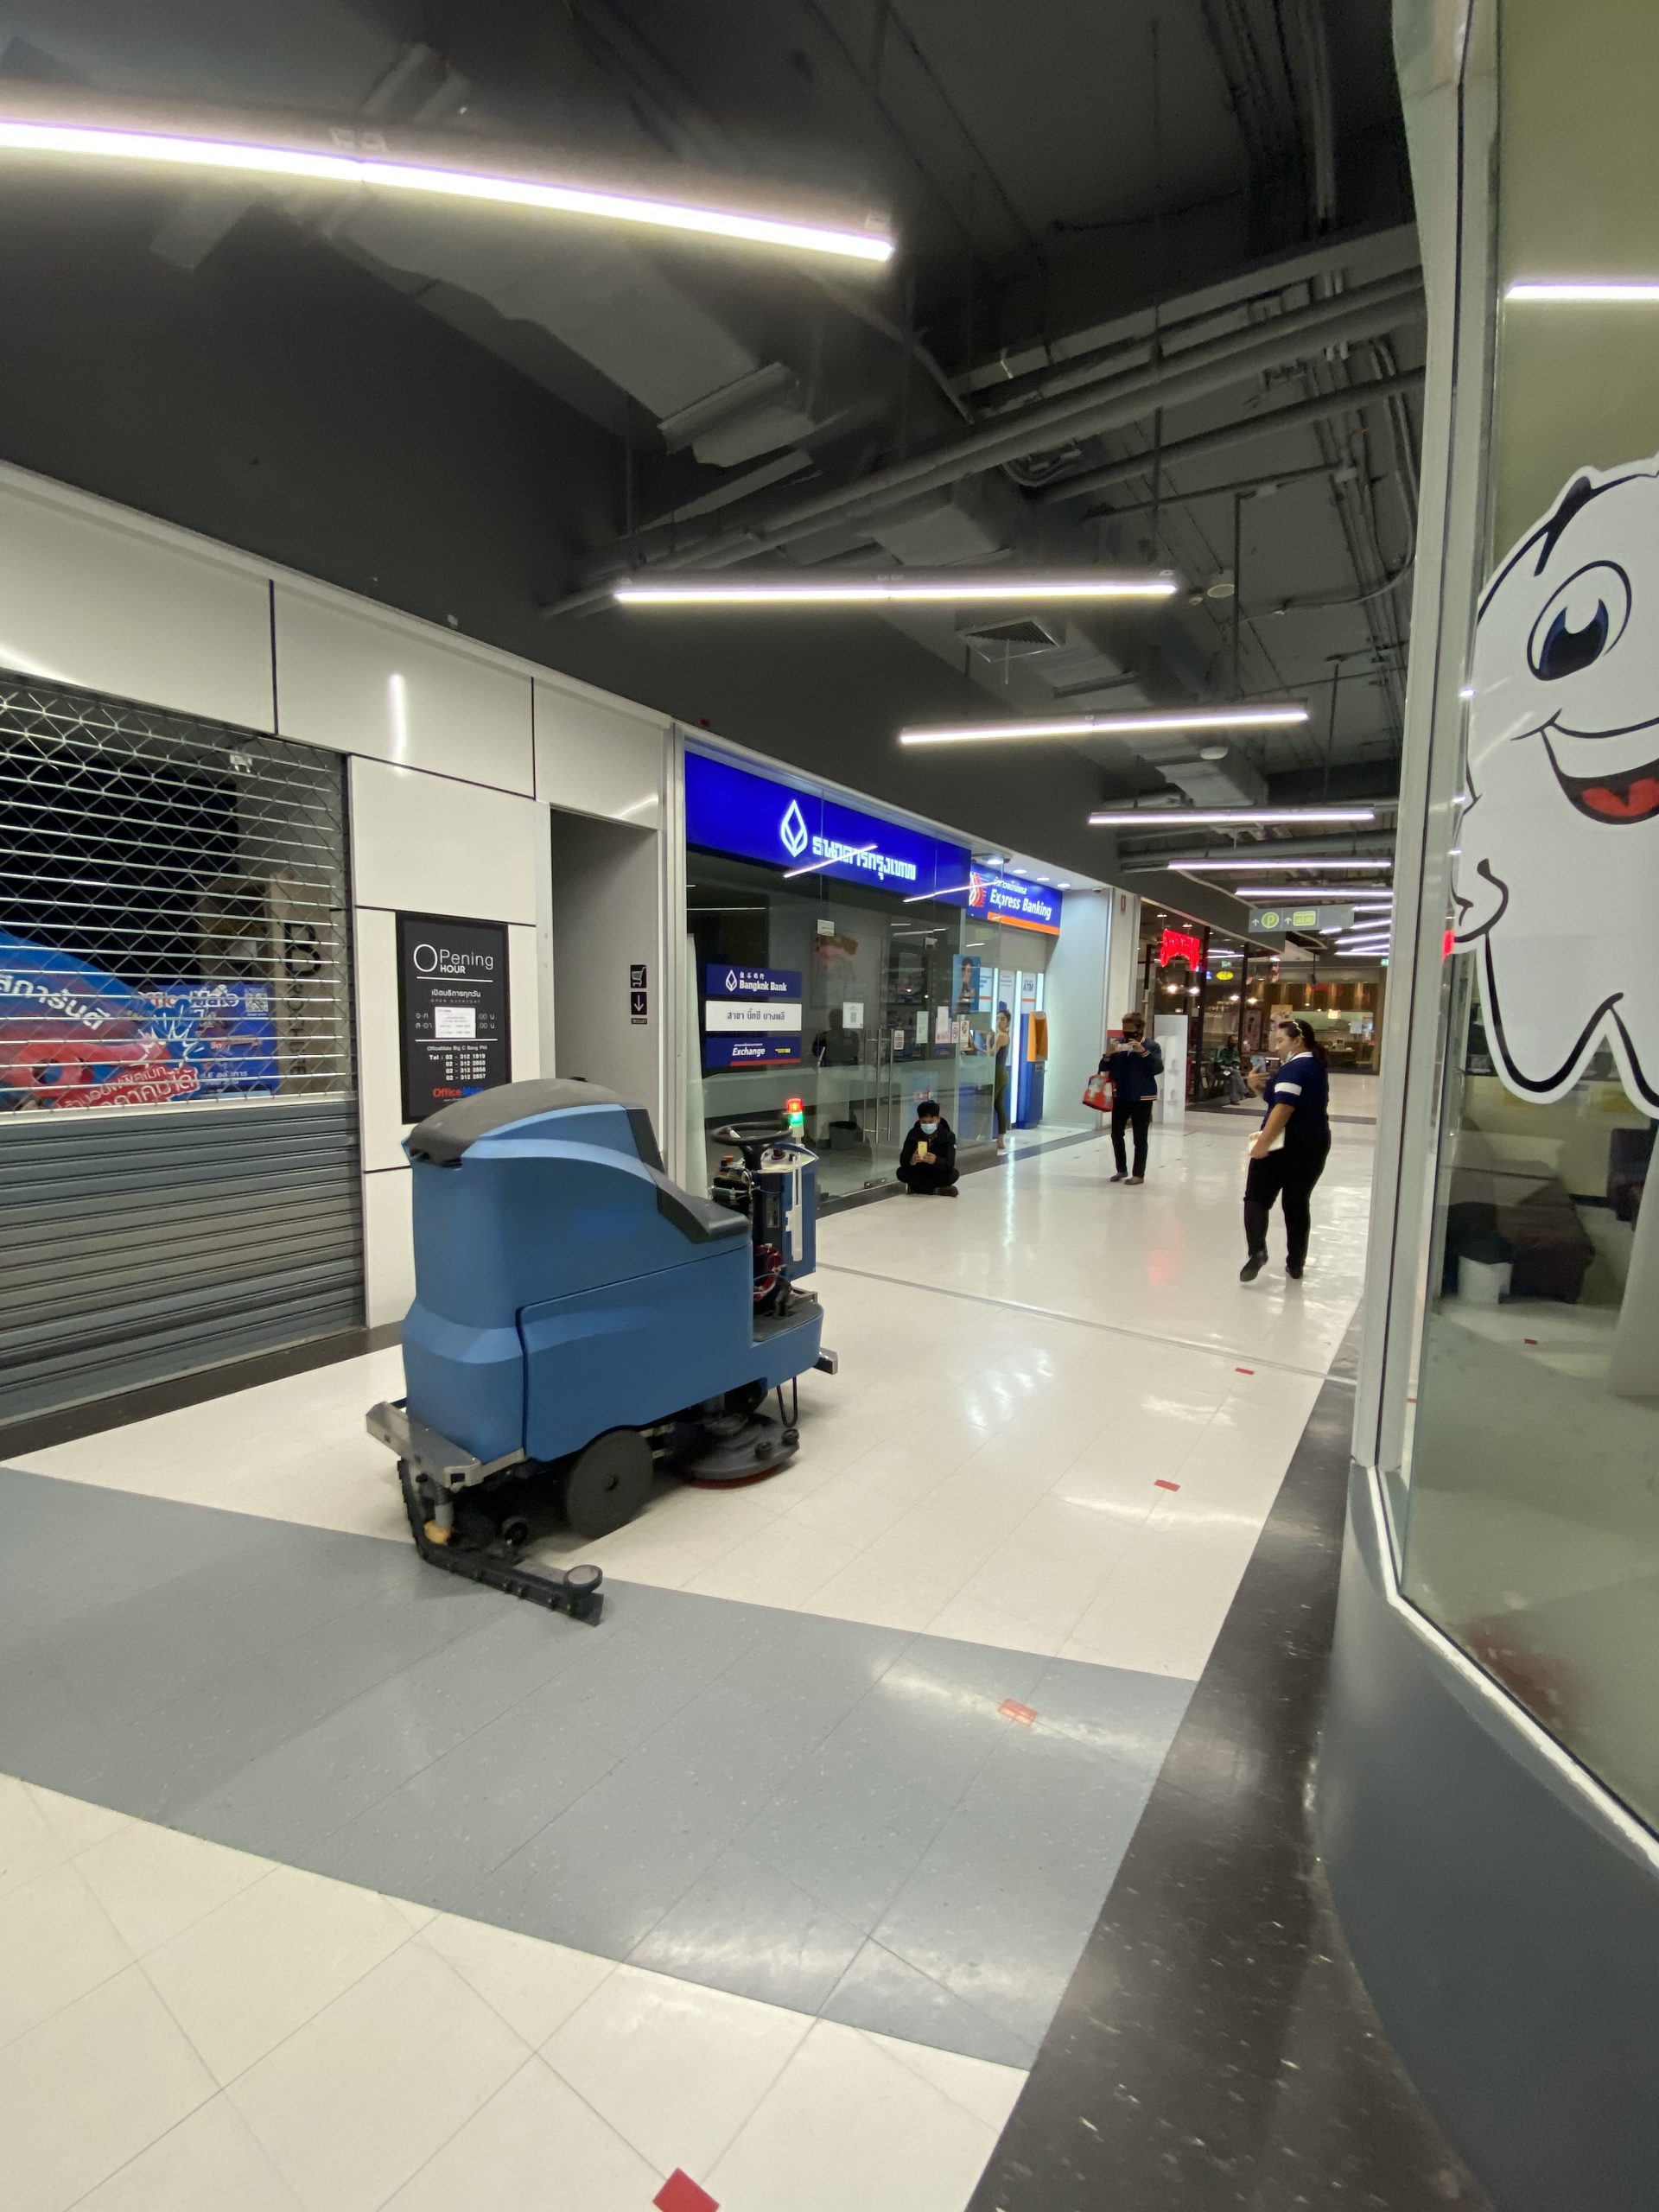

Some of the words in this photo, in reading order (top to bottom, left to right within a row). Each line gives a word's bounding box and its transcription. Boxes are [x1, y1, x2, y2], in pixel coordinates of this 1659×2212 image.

[989, 888, 1021, 910] Express
[1021, 897, 1052, 921] Banking
[440, 964, 466, 974] HOUR
[739, 979, 769, 992] Bangkok
[770, 982, 787, 992] Bank
[732, 1047, 766, 1057] Exchange
